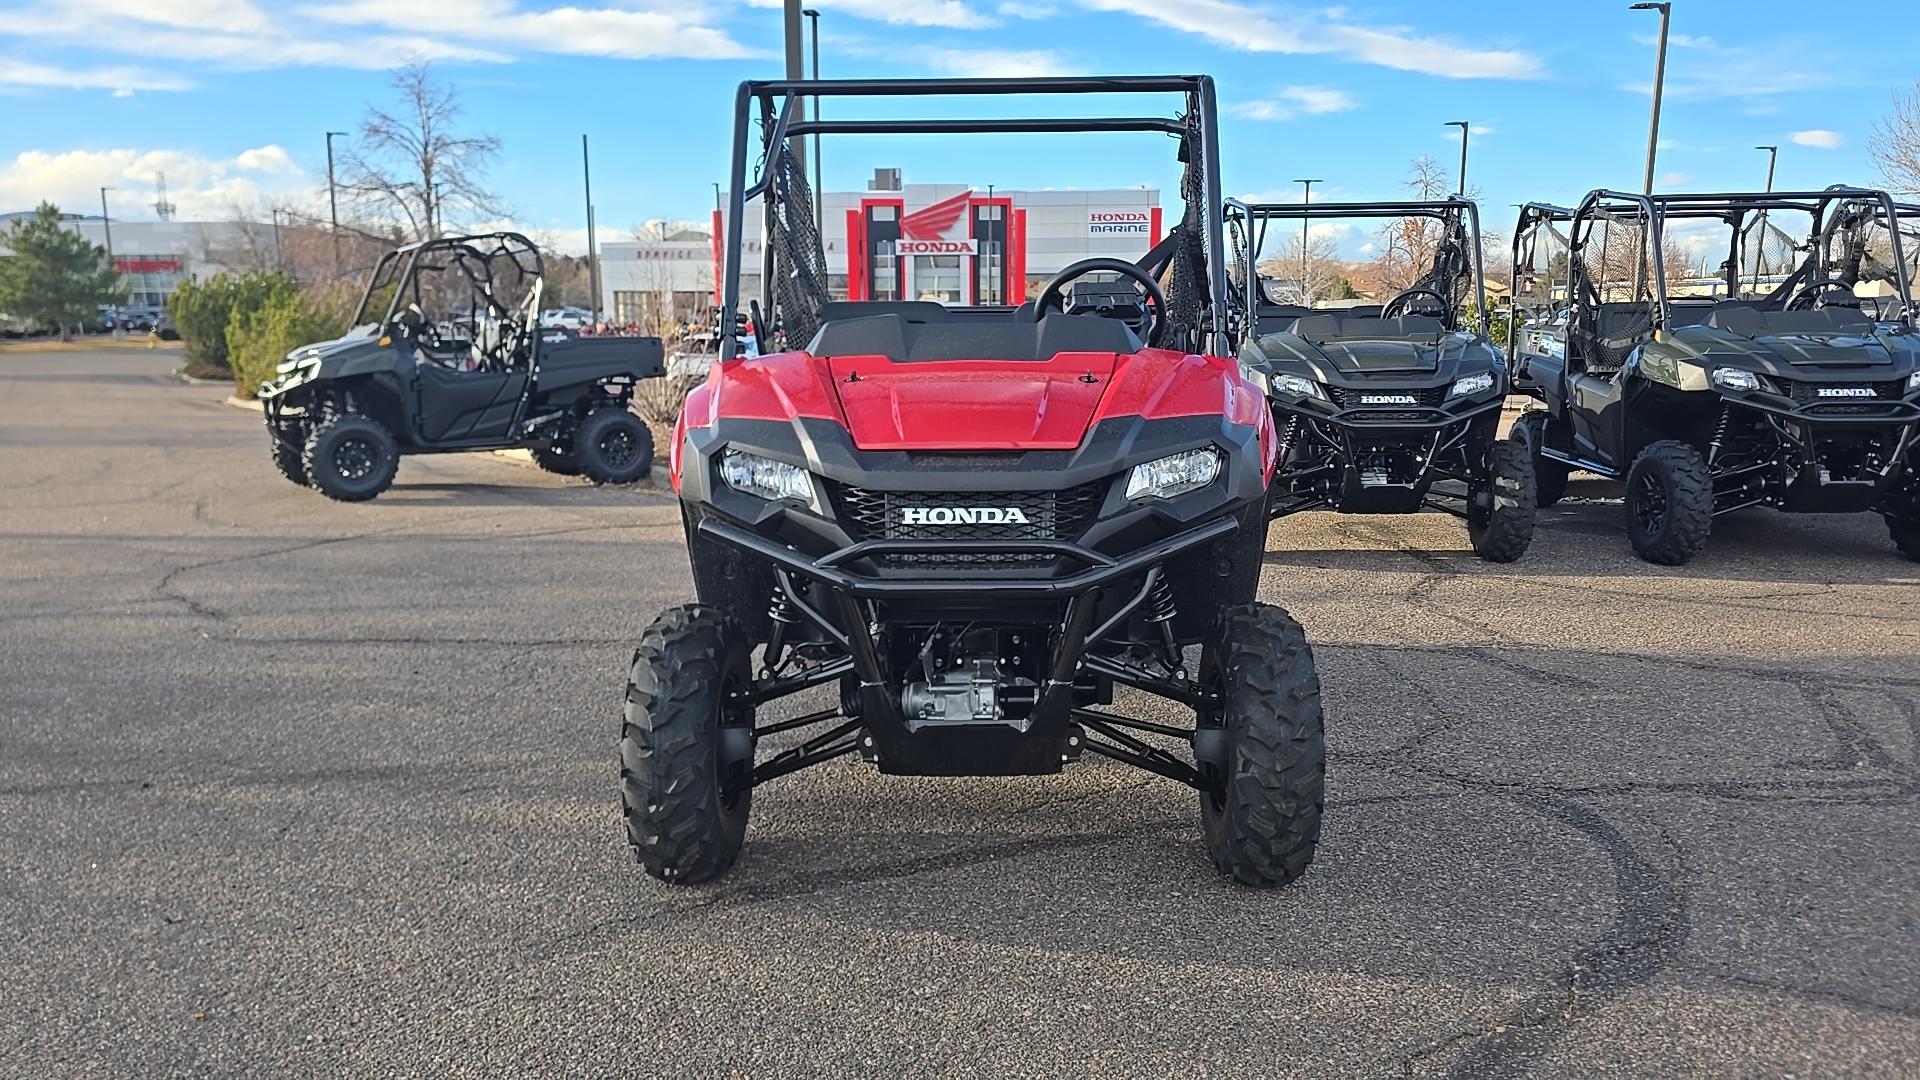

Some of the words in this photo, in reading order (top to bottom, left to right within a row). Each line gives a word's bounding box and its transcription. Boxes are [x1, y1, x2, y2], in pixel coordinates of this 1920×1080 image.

[1091, 213, 1148, 221] HONDA
[900, 242, 973, 253] HONDA
[1817, 388, 1877, 396] HONDA
[1361, 395, 1417, 403] HONDA
[902, 507, 1029, 524] HONDA
